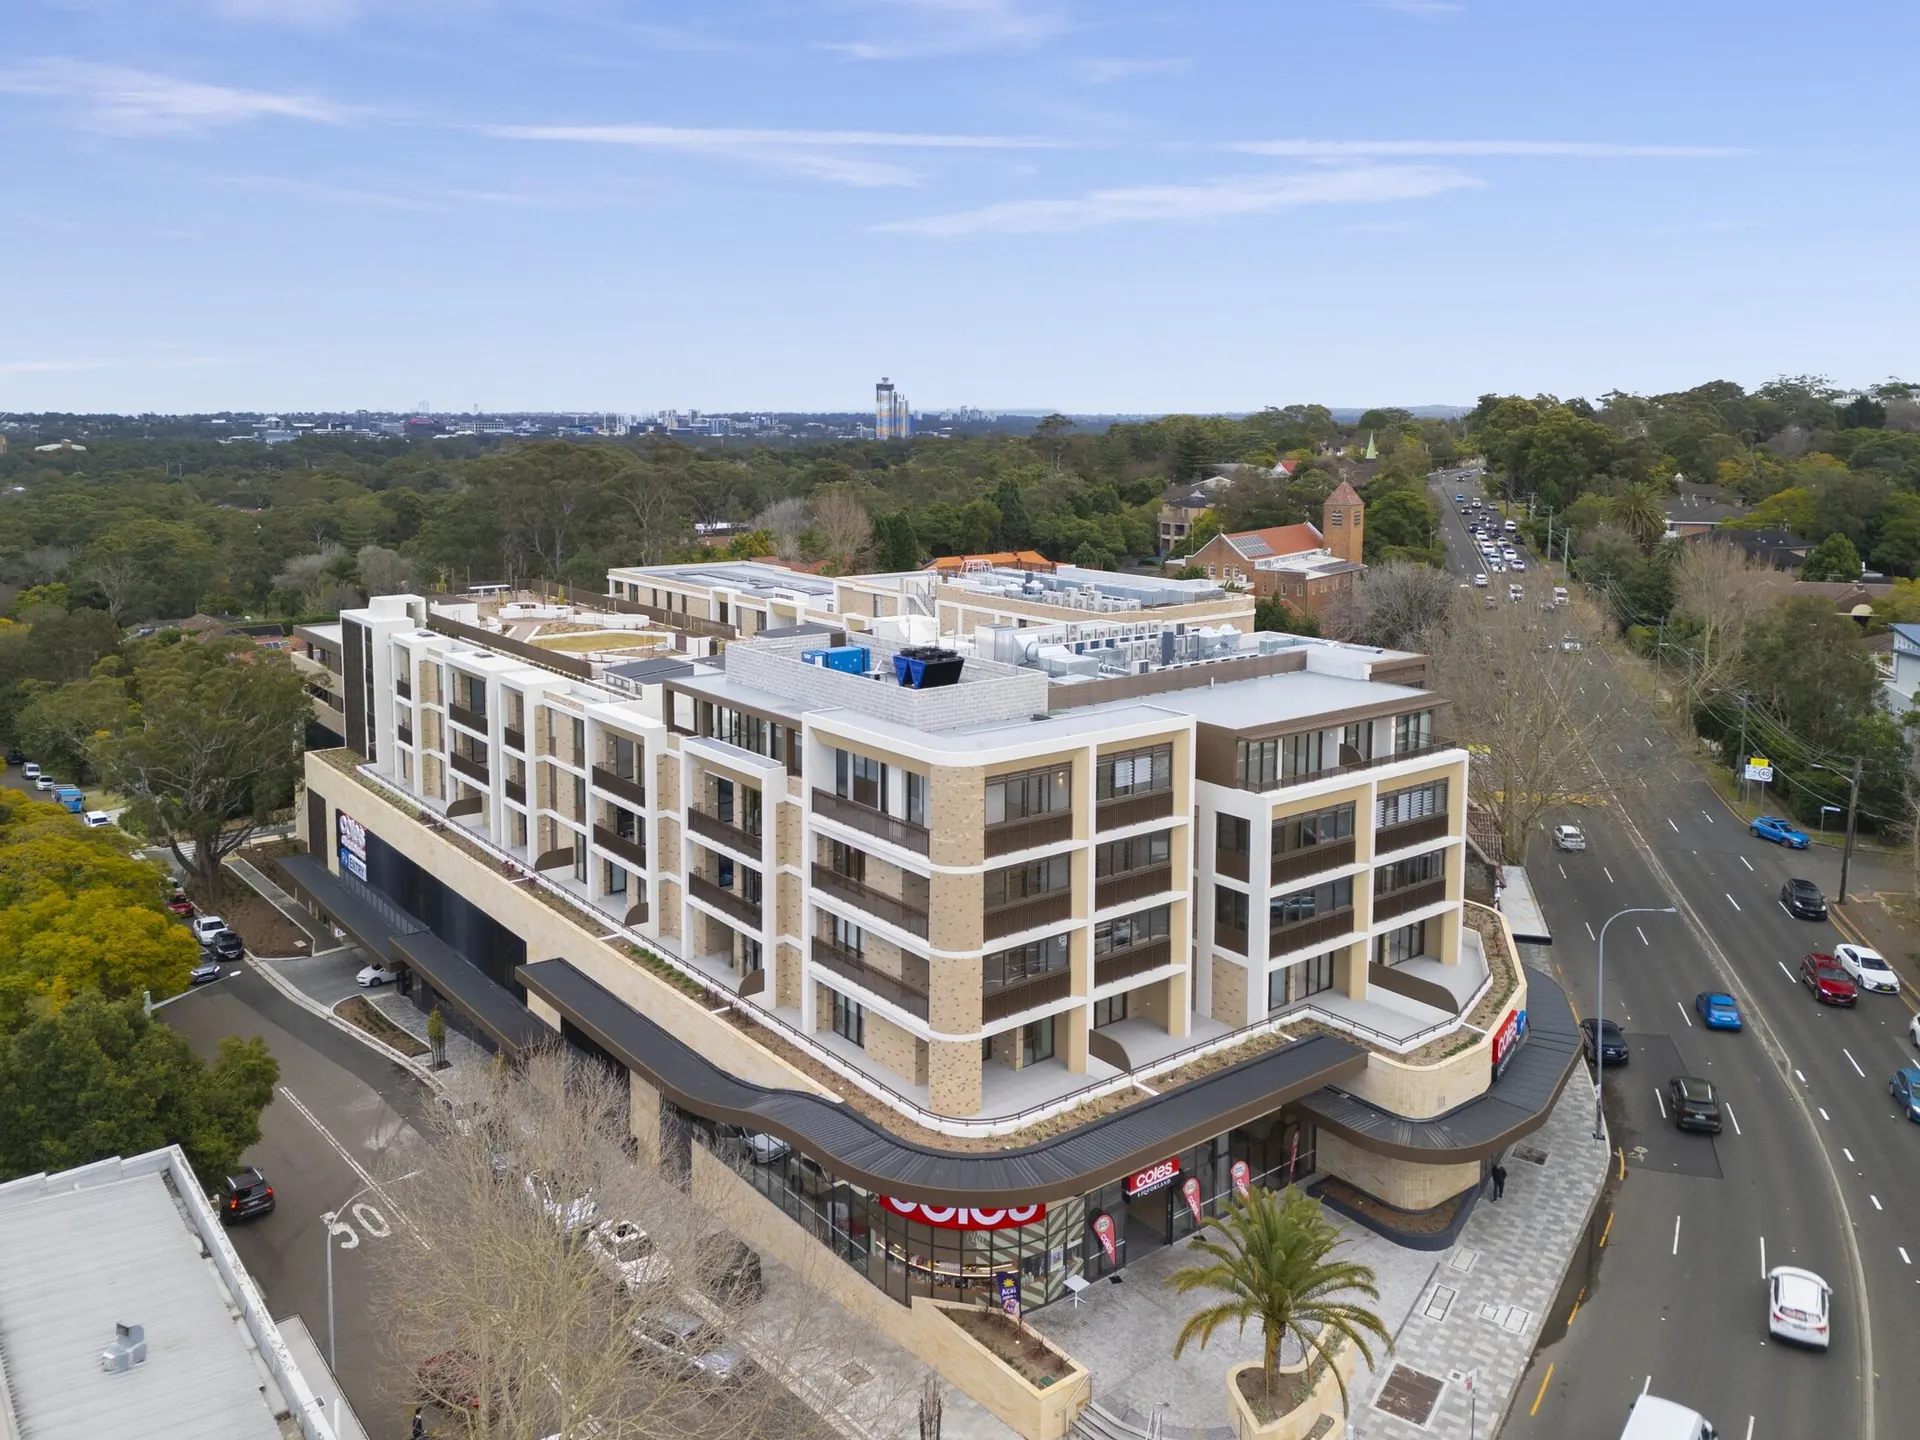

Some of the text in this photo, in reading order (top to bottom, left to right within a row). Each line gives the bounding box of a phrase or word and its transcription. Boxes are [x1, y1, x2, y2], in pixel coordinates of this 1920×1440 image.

[349, 857, 365, 877] ENTRY
[1498, 1015, 1518, 1058] coles
[1136, 1162, 1173, 1187] coles
[1137, 1178, 1172, 1198] LIQUORLAND
[320, 1203, 392, 1249] 50
[1100, 1233, 1114, 1254] coles
